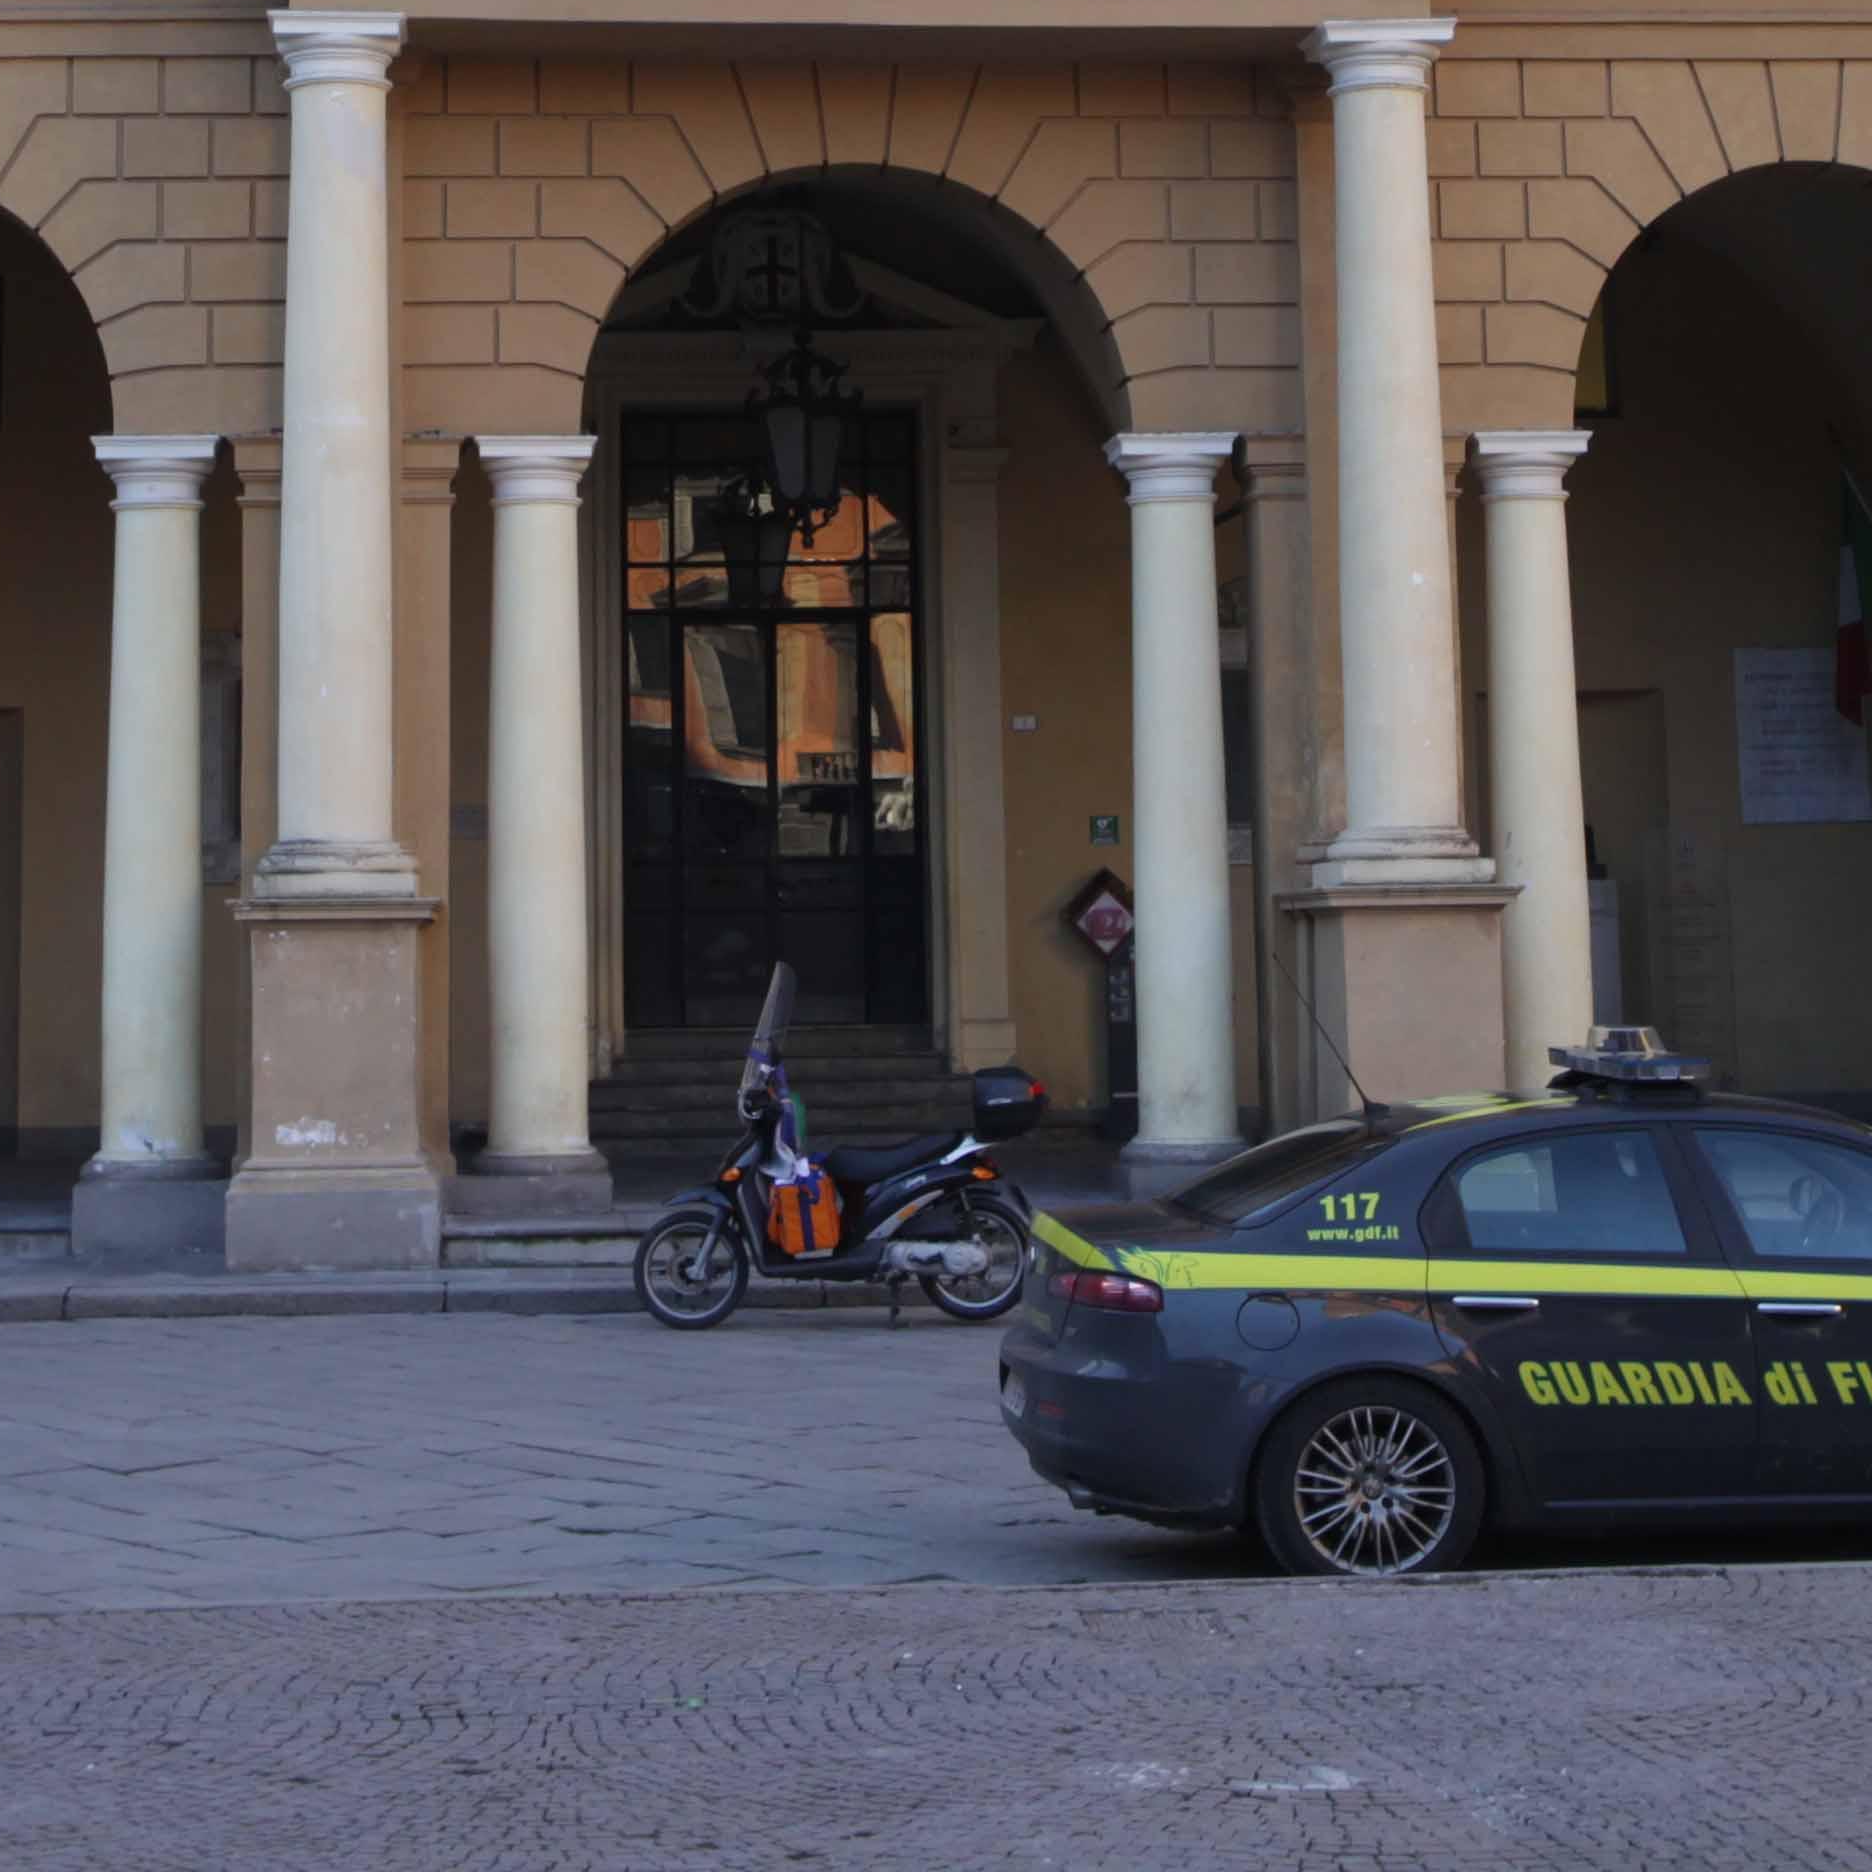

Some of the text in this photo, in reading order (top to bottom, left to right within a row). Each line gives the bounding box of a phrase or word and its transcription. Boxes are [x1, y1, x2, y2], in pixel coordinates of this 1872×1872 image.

[1319, 1191, 1380, 1221] 117
[1307, 1225, 1399, 1243] www.gdf.it
[1518, 1361, 1753, 1406] GUARDIA
[1764, 1361, 1818, 1406] di
